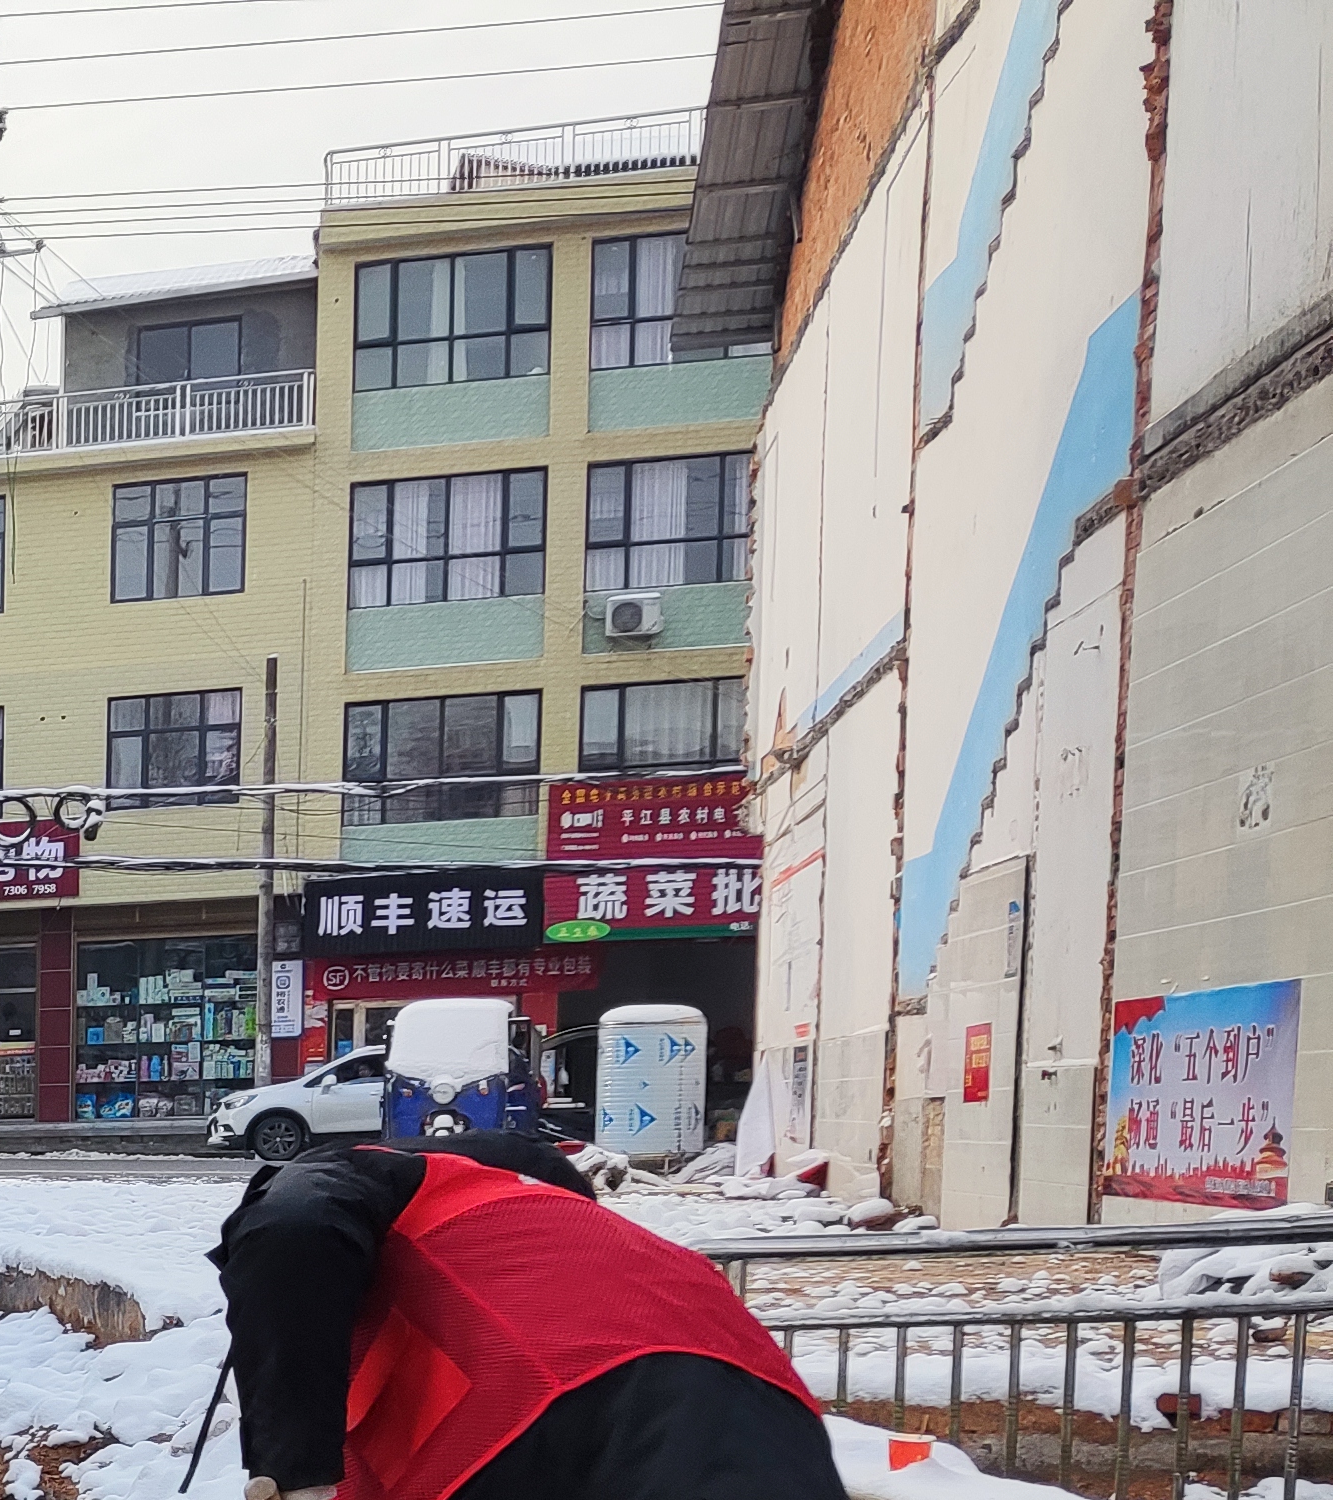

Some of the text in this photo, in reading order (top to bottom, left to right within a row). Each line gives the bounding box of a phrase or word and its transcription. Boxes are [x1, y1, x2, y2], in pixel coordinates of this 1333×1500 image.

[3, 885, 28, 896] 7306
[32, 883, 57, 895] 7958
[317, 887, 529, 937] 顺丰速运
[328, 972, 345, 985] SF
